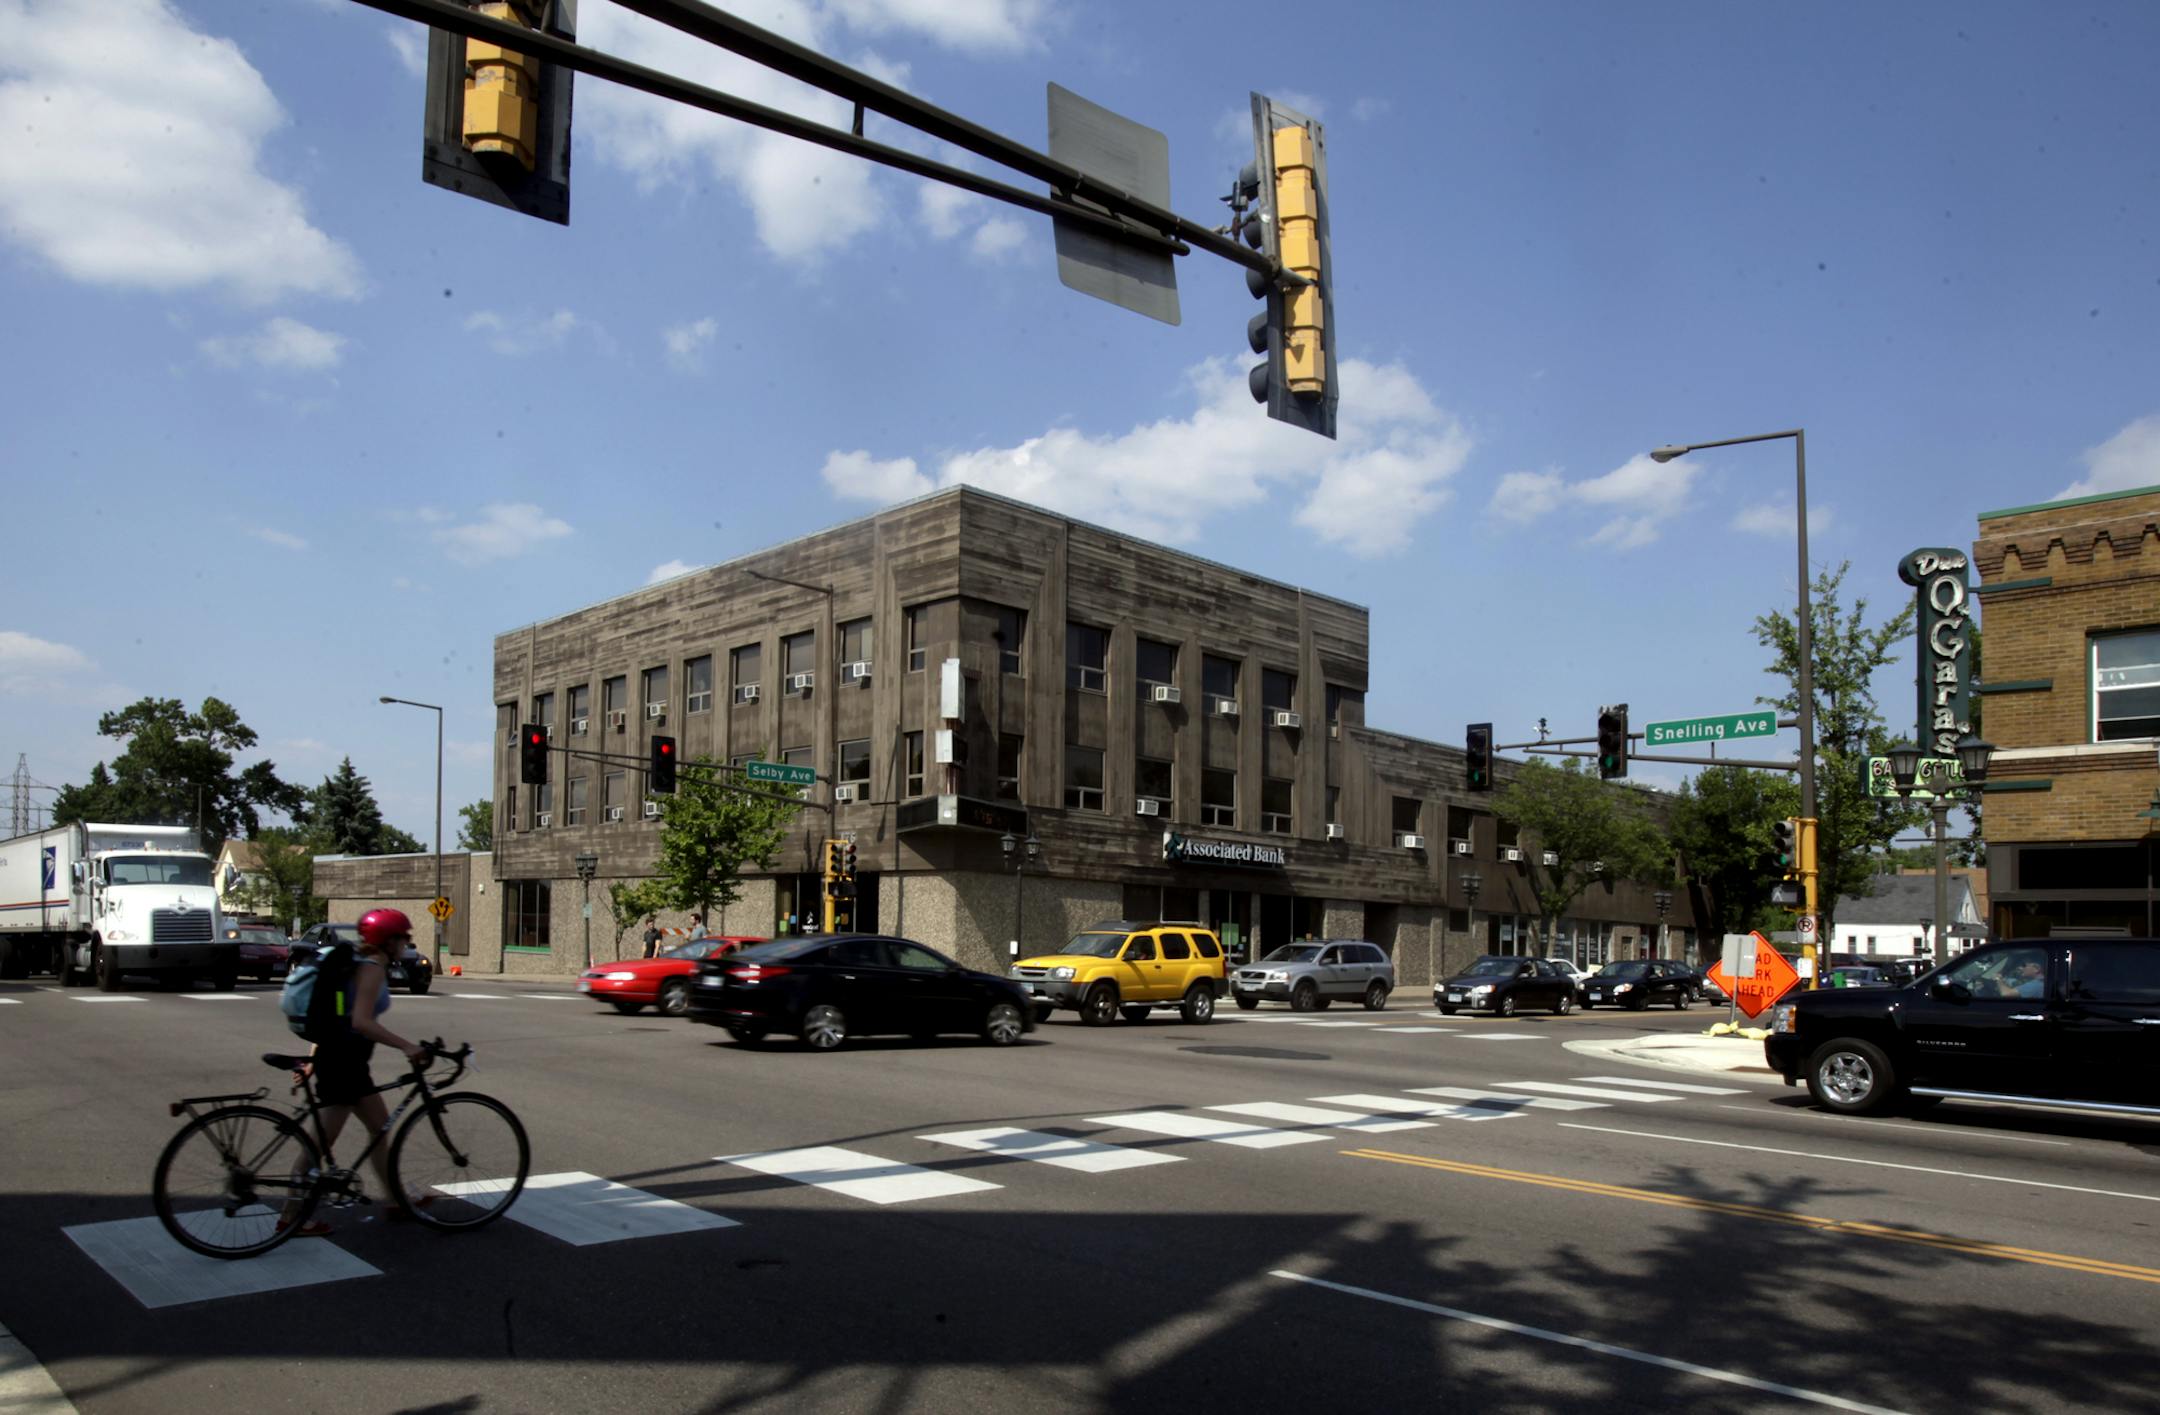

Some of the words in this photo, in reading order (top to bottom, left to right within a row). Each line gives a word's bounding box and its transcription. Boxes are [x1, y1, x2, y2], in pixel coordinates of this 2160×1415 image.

[1654, 724, 1725, 740] Snelling
[1735, 720, 1768, 733] Ave
[753, 766, 784, 780] Selby
[790, 770, 811, 780] Ave
[1873, 761, 1893, 776] BA
[1183, 839, 1250, 861] Associated
[1253, 845, 1285, 864] Bank
[1755, 953, 1771, 965] AD
